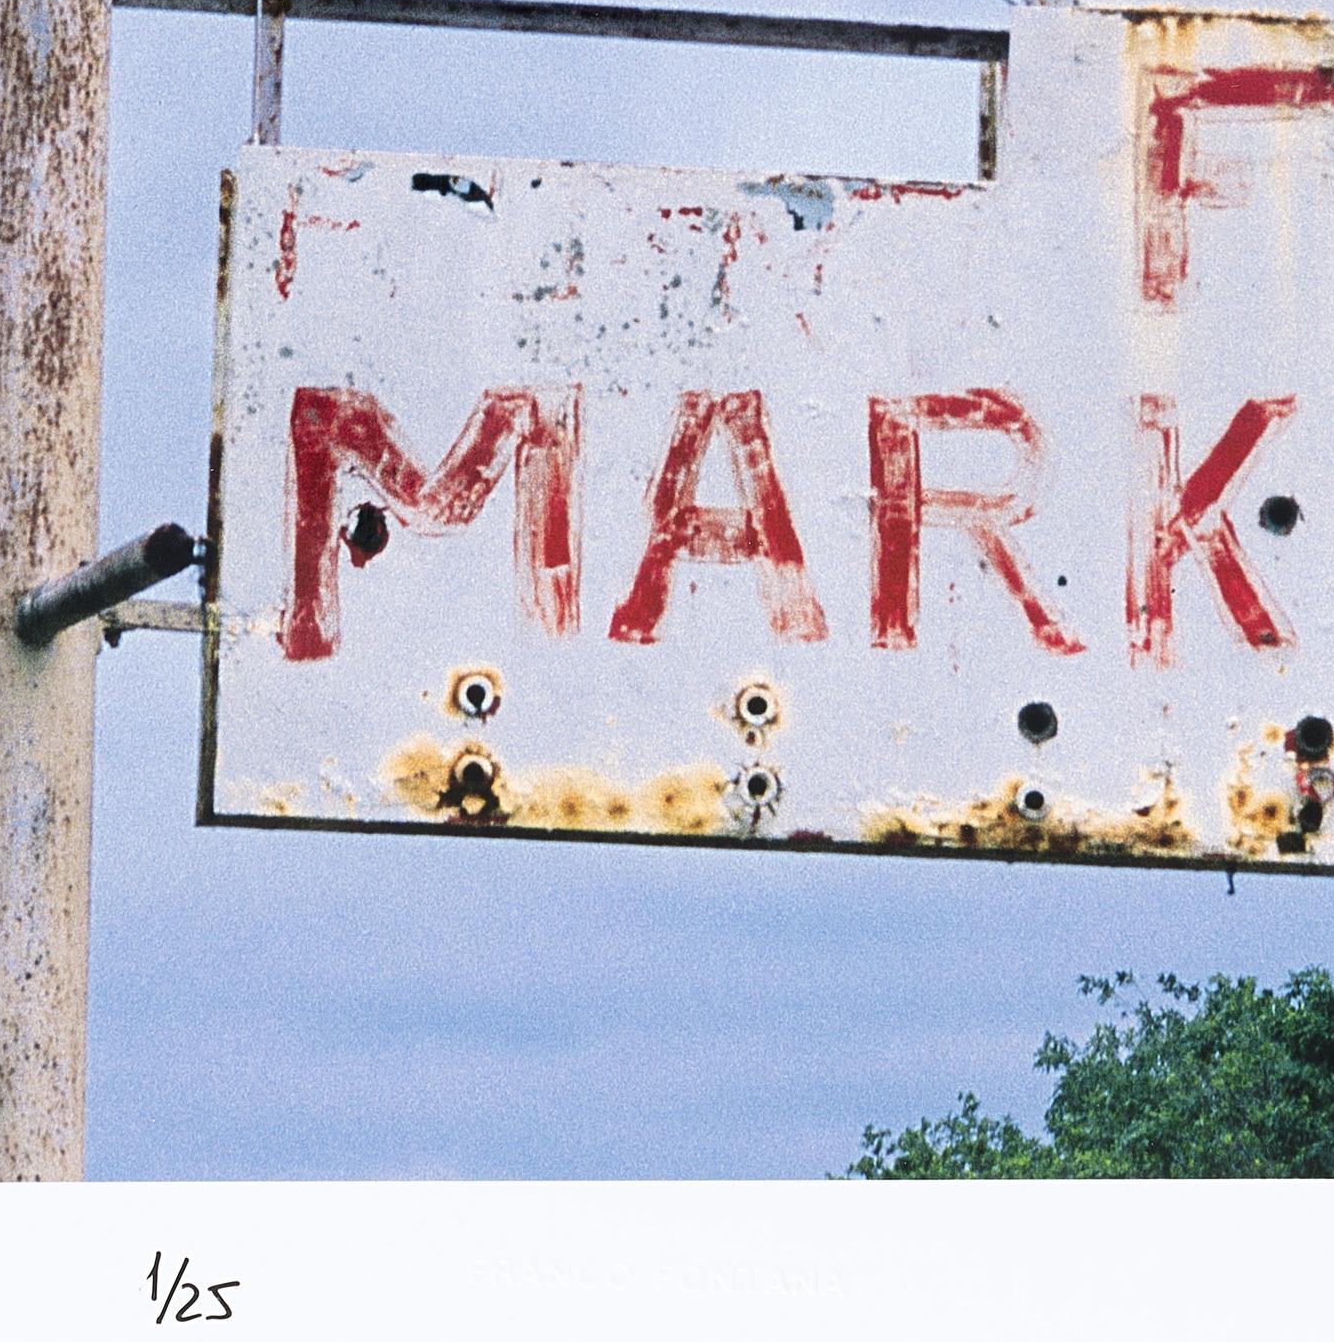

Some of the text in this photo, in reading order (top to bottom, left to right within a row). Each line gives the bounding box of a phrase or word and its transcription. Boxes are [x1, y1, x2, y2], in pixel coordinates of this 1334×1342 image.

[146, 1250, 241, 1325] 1/25
[468, 1258, 849, 1300] FRANCO FONTANA
